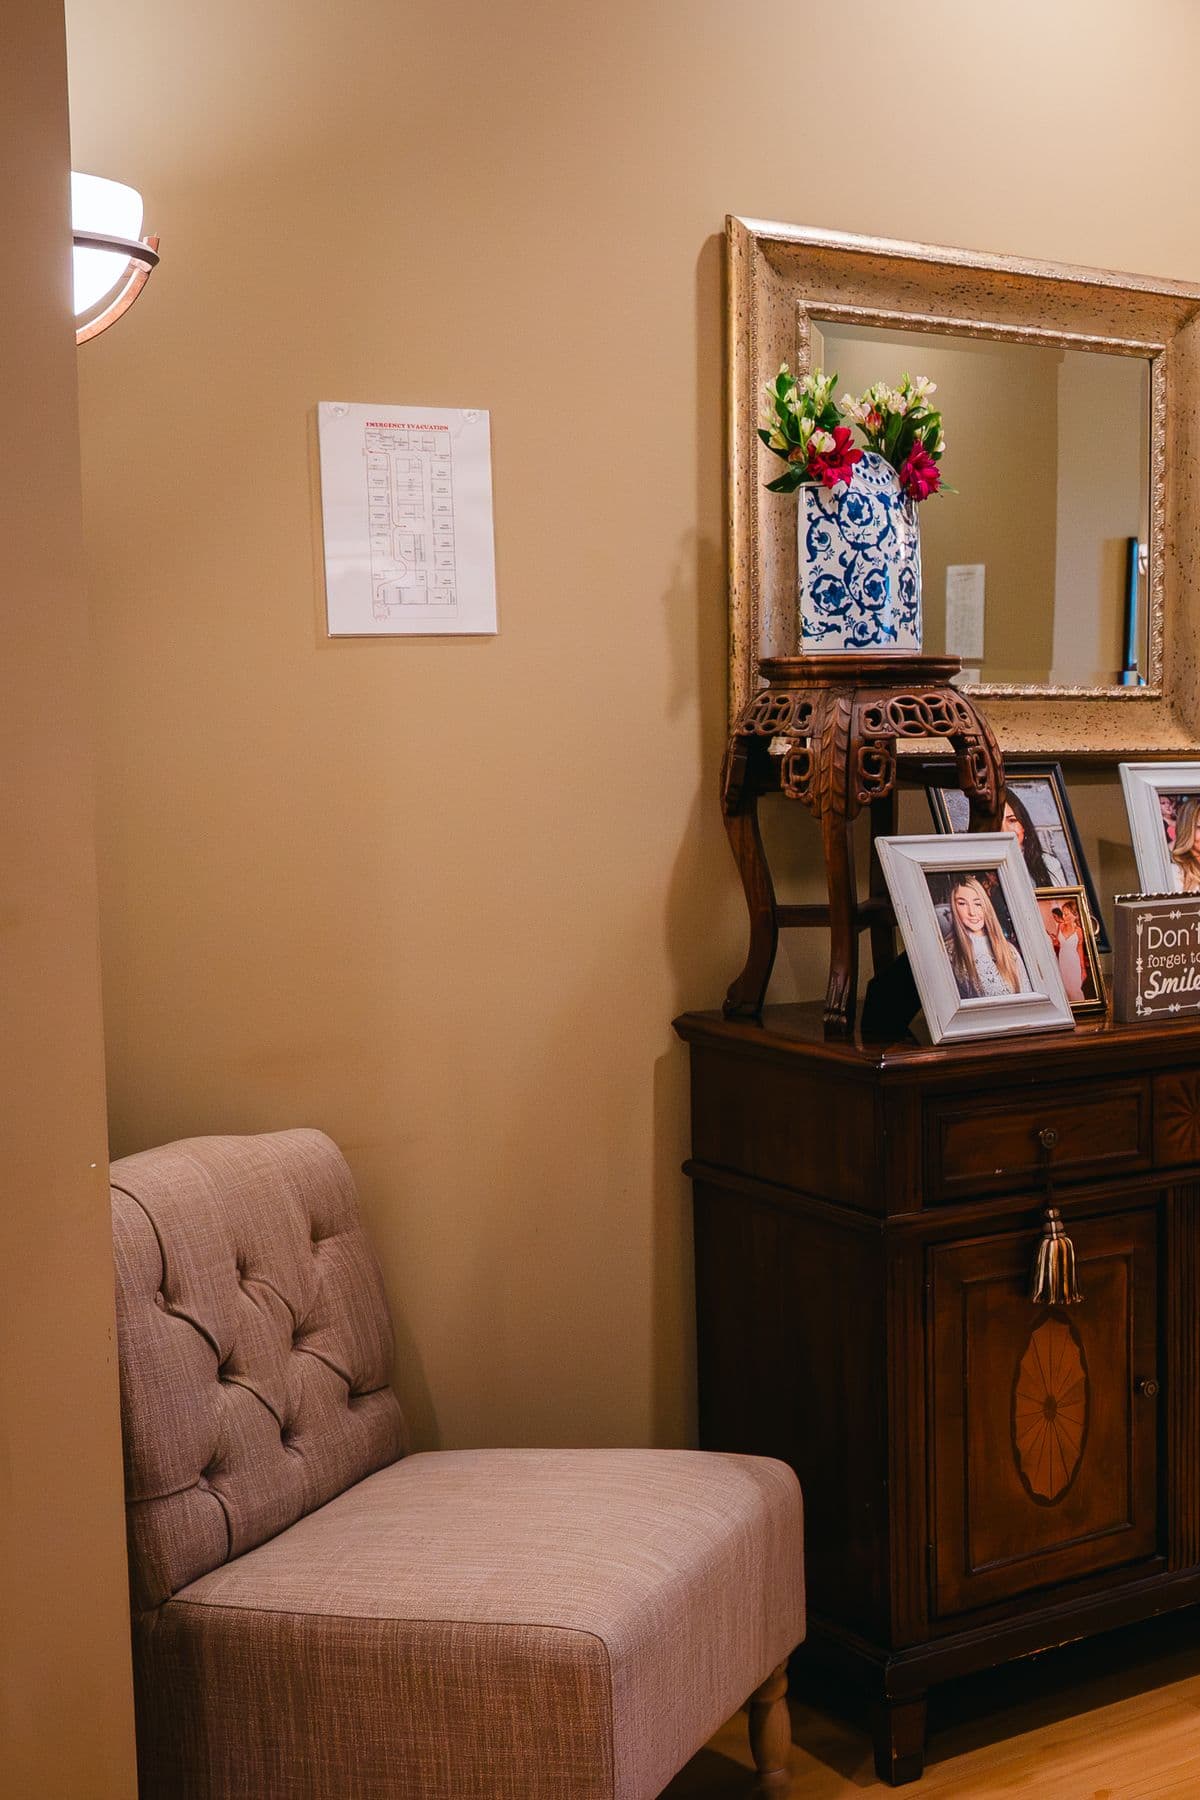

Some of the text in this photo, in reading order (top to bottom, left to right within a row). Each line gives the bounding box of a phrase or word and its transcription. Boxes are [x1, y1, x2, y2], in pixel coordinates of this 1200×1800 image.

[366, 421, 449, 431] EMERGENCY EVACUATION
[1147, 952, 1187, 969] forget
